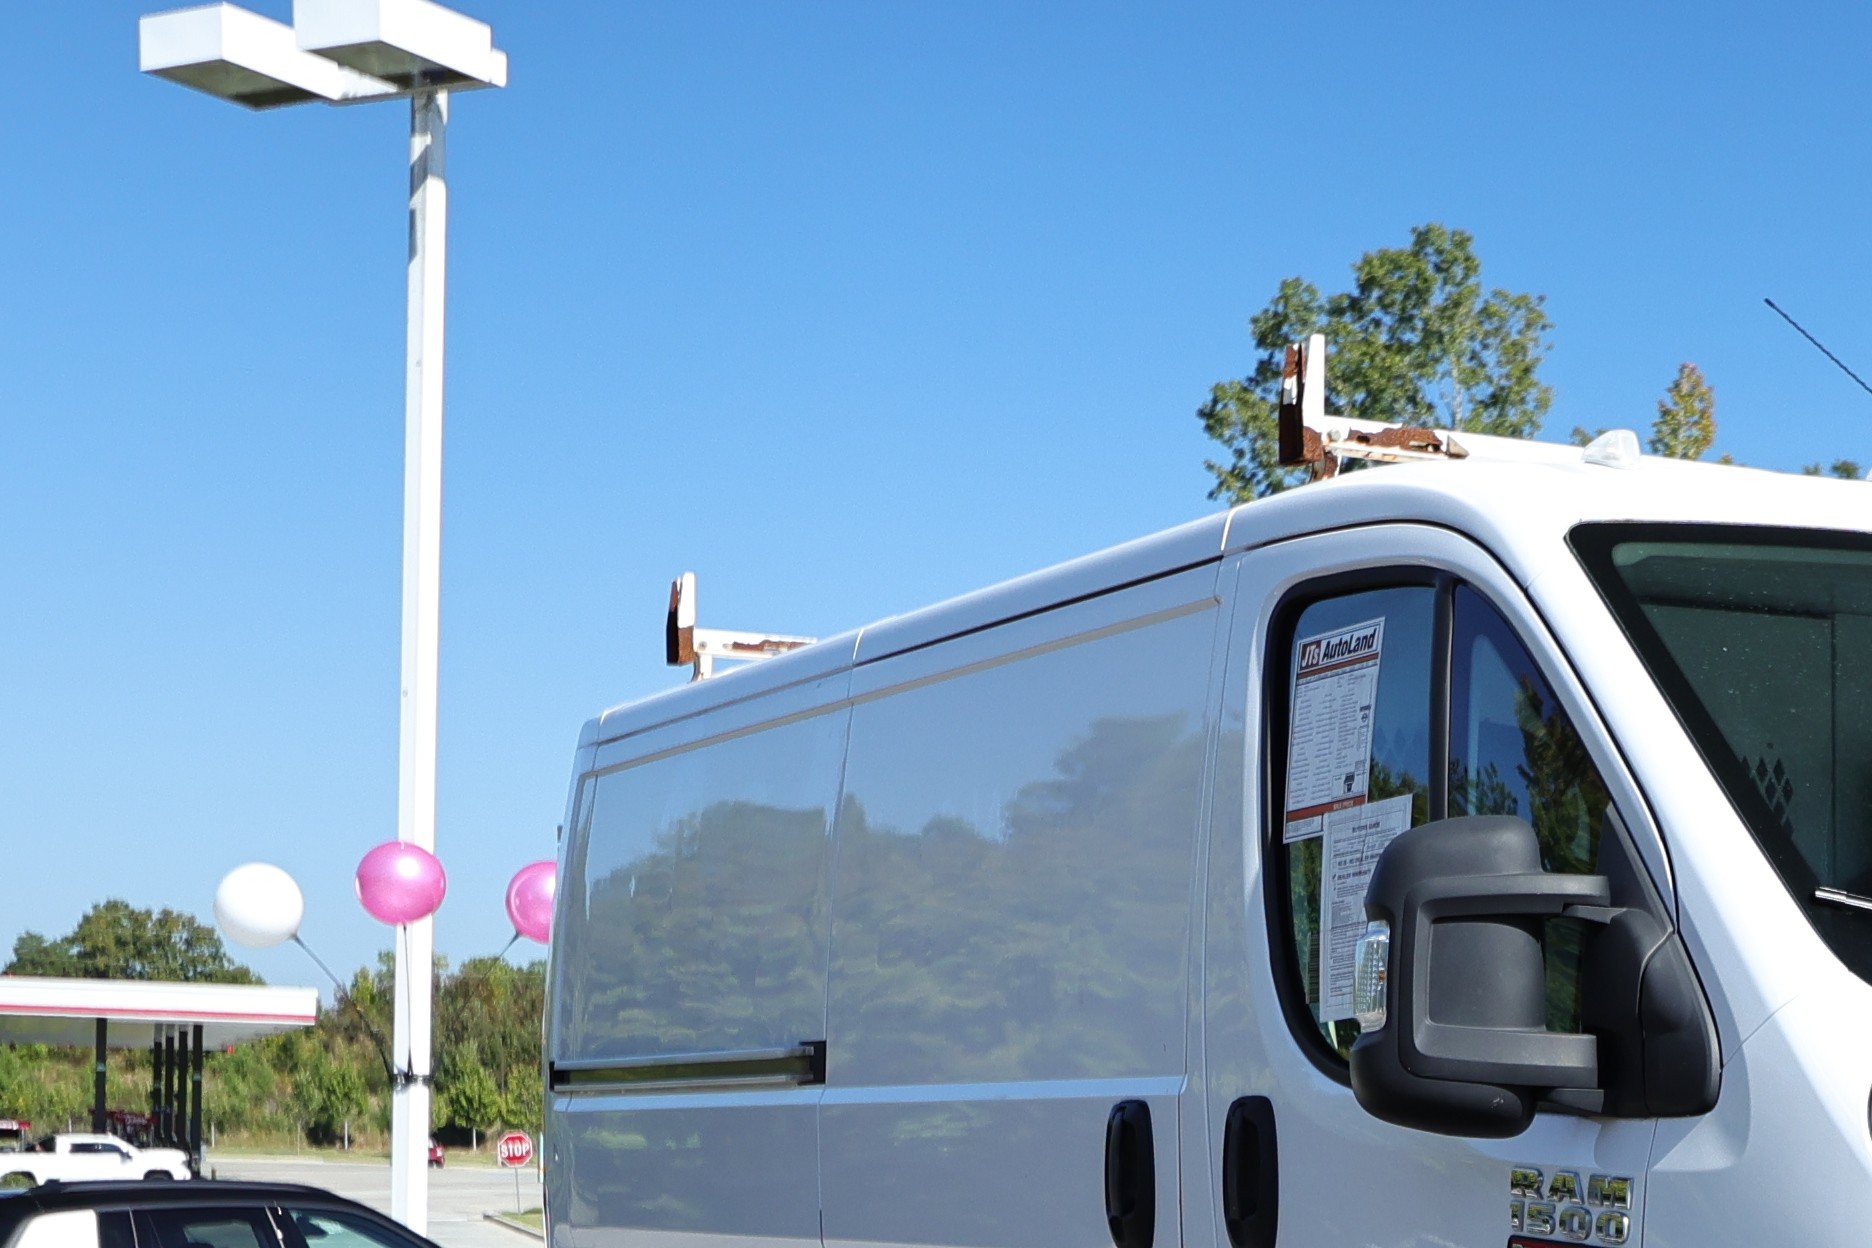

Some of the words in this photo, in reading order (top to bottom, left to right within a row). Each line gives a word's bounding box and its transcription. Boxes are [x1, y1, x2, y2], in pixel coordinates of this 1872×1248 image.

[1301, 643, 1320, 668] JTs
[1322, 627, 1378, 662] AutoLand
[500, 1139, 530, 1158] STOP
[1510, 1166, 1634, 1210] RAM
[1509, 1199, 1631, 1245] 1500
